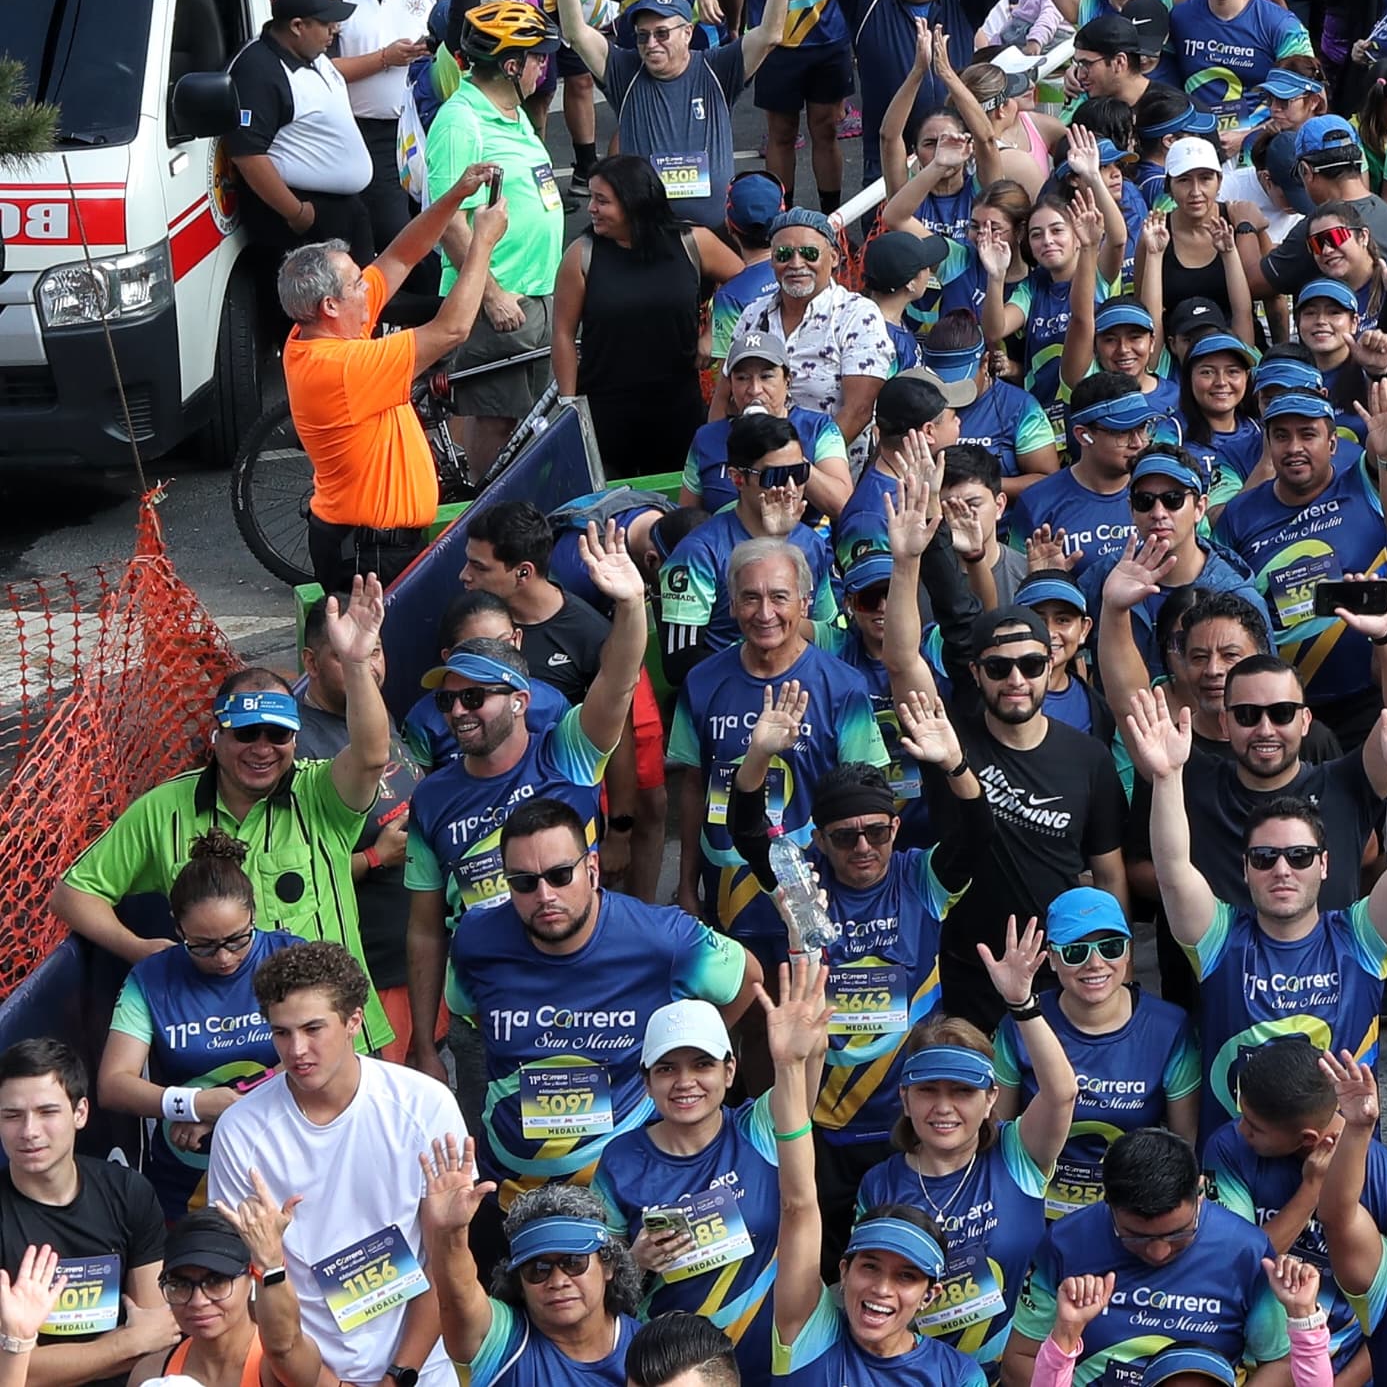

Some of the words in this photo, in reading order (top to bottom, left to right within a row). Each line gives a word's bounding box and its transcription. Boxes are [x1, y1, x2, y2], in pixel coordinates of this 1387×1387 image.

[834, 993, 891, 1011] 3642
[536, 1006, 635, 1027] Carrera
[845, 1023, 883, 1032] MEDALLA
[535, 1031, 568, 1048] San
[536, 1093, 594, 1114] 3097
[548, 1126, 587, 1134] MEDALLA
[686, 1253, 728, 1274] MEDALLA
[342, 1265, 398, 1300] 1156
[364, 1293, 404, 1317] MEDALLA
[54, 1322, 95, 1332] MEDALLA
[940, 1313, 979, 1332] MEDALLA
